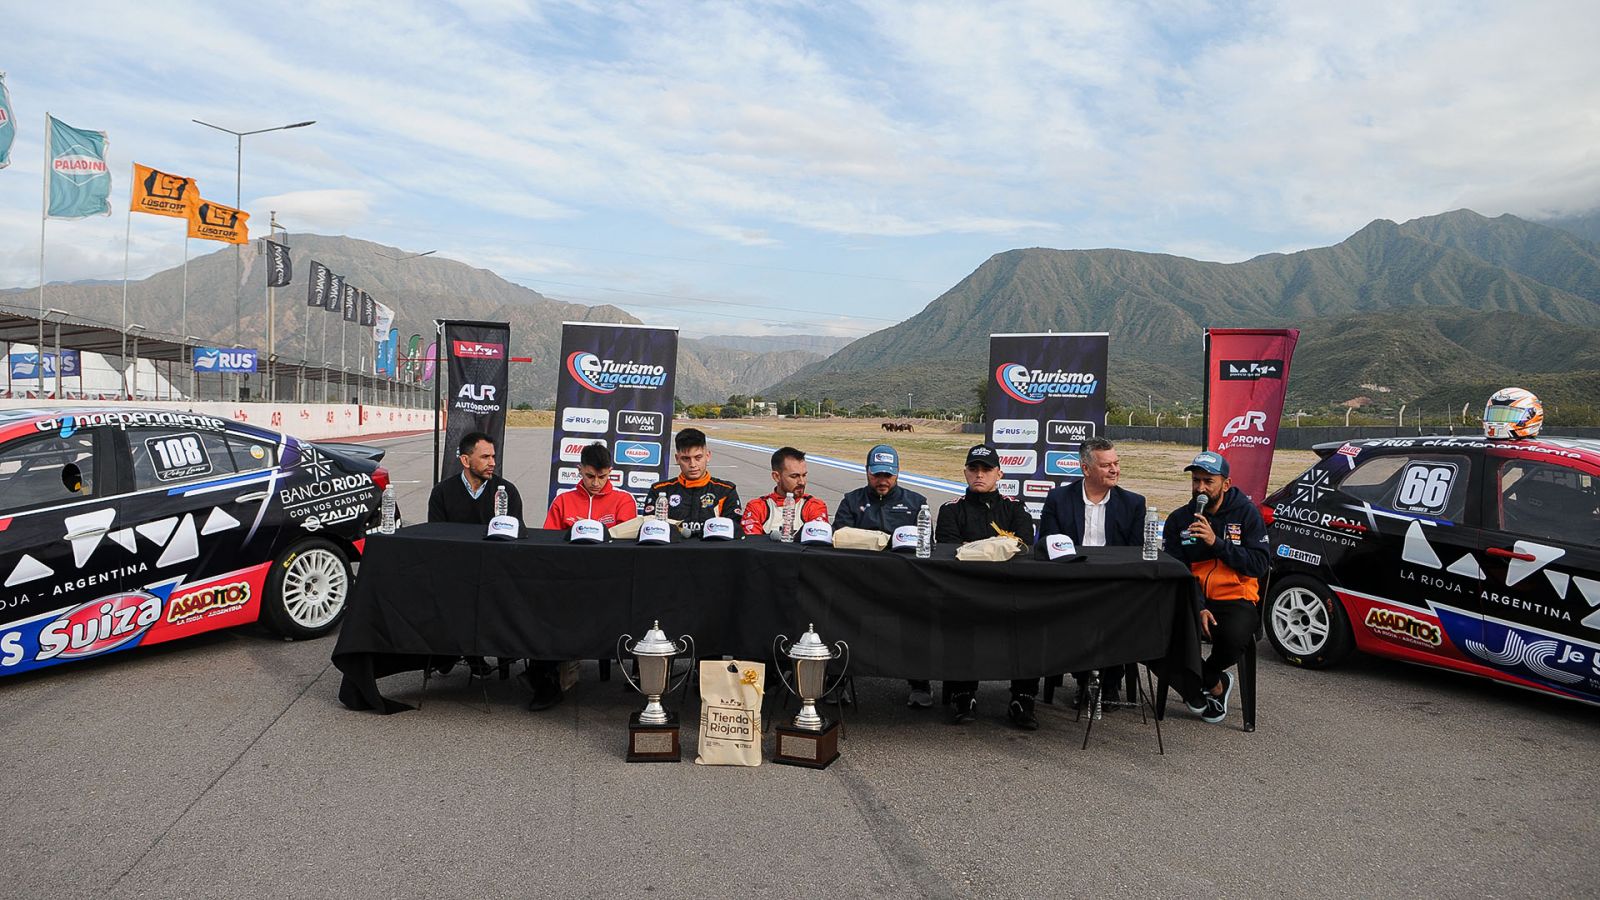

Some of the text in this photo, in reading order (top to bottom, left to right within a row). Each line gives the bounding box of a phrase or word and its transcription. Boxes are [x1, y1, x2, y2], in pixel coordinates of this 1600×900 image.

[54, 160, 106, 172] PALADINI
[219, 353, 252, 368] RUS
[602, 360, 664, 375] Turismo
[599, 372, 667, 386] nacional
[1030, 369, 1095, 383] Turismo
[1027, 380, 1098, 394] nacional
[624, 414, 655, 425] KAVAK
[1055, 424, 1086, 435] KAVAK
[154, 436, 203, 469] 108
[280, 480, 331, 504] BANCO
[1399, 465, 1451, 507] 66
[290, 507, 310, 518] CON
[313, 502, 332, 512] VOS
[334, 496, 358, 507] CADA
[1273, 503, 1320, 523] BANCO
[1274, 521, 1292, 533] CON
[1294, 526, 1311, 536] VOS
[1313, 529, 1338, 543] CADA
[52, 562, 148, 596] ARGENTINA
[1400, 569, 1415, 581] LA
[1421, 574, 1462, 593] RIOJA
[1481, 590, 1572, 621] ARGENTINA
[35, 597, 163, 661] Suiza
[712, 711, 749, 724] Tienda
[710, 722, 749, 735] Riojana
